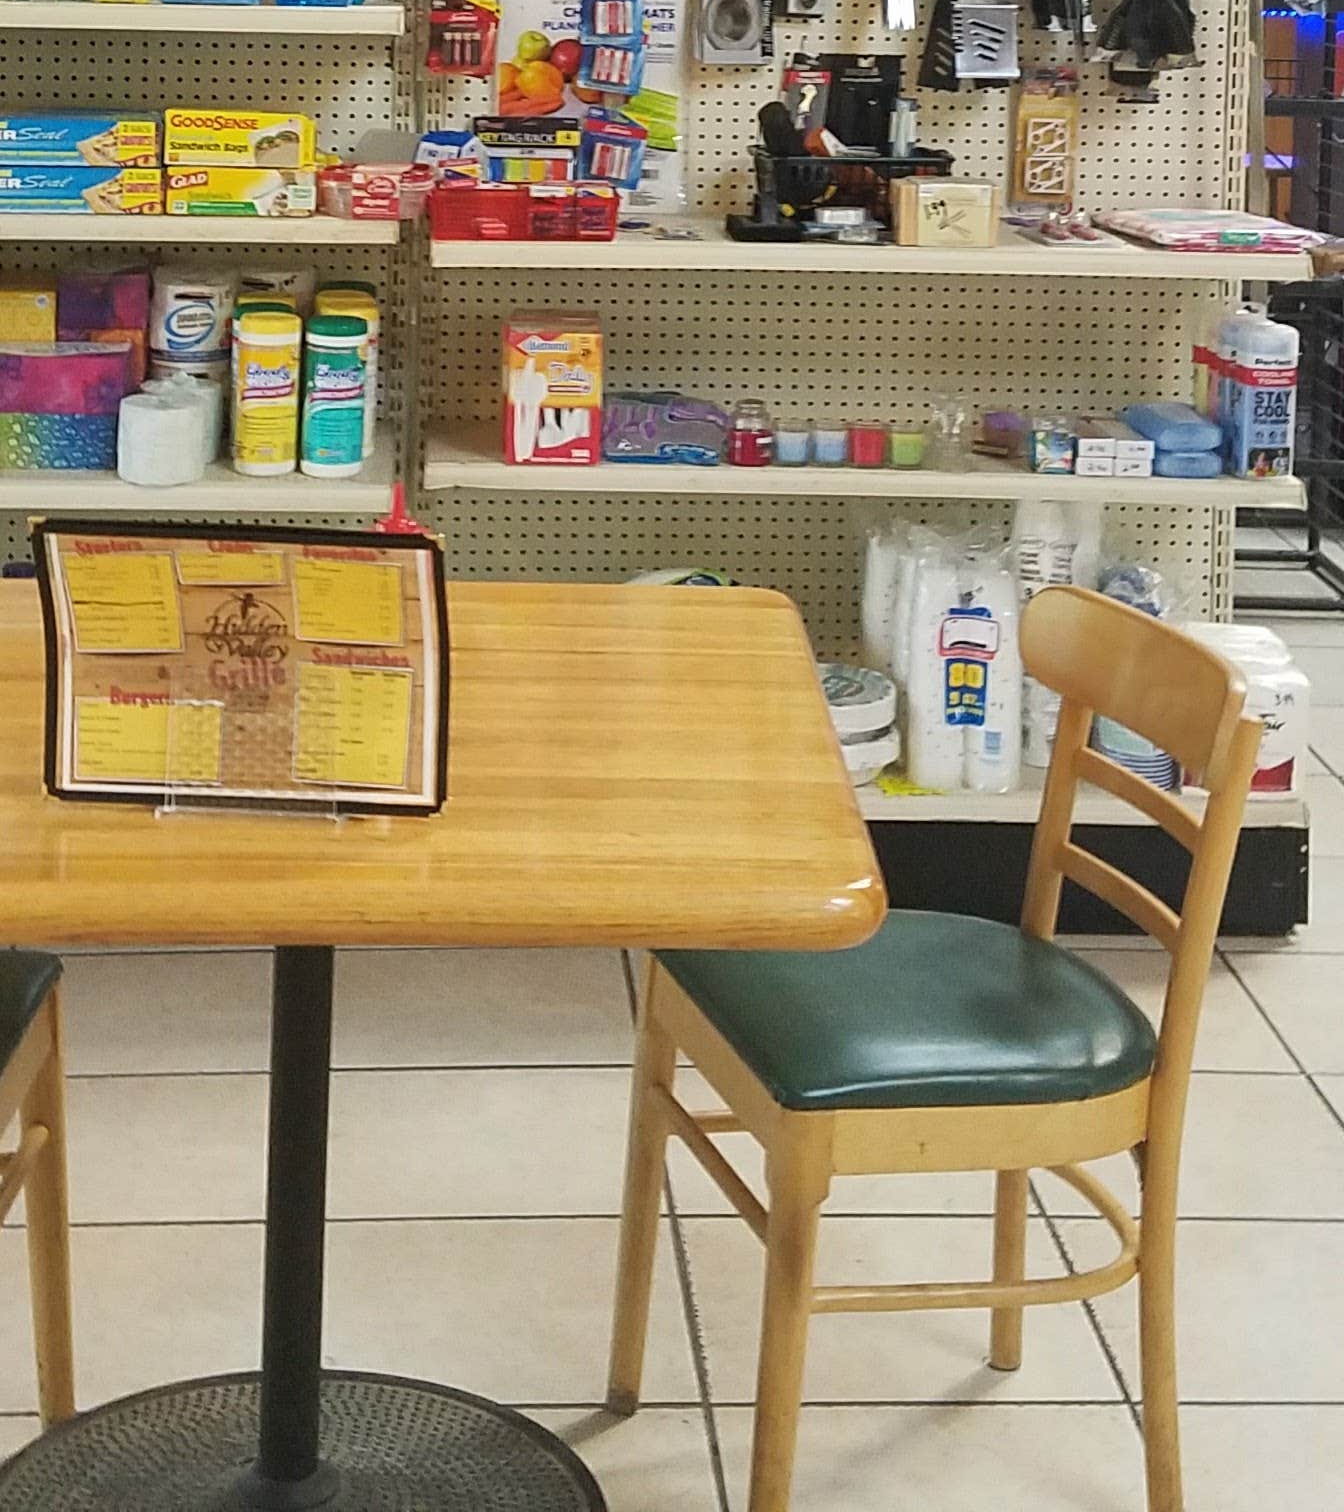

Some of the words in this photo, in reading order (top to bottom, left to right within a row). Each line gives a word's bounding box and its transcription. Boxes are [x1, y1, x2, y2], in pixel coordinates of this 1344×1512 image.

[169, 141, 222, 152] Sandwich
[170, 173, 207, 188] GLAD
[1254, 391, 1291, 405] STAY
[1254, 405, 1291, 417] COOL
[205, 615, 289, 637] Hidden
